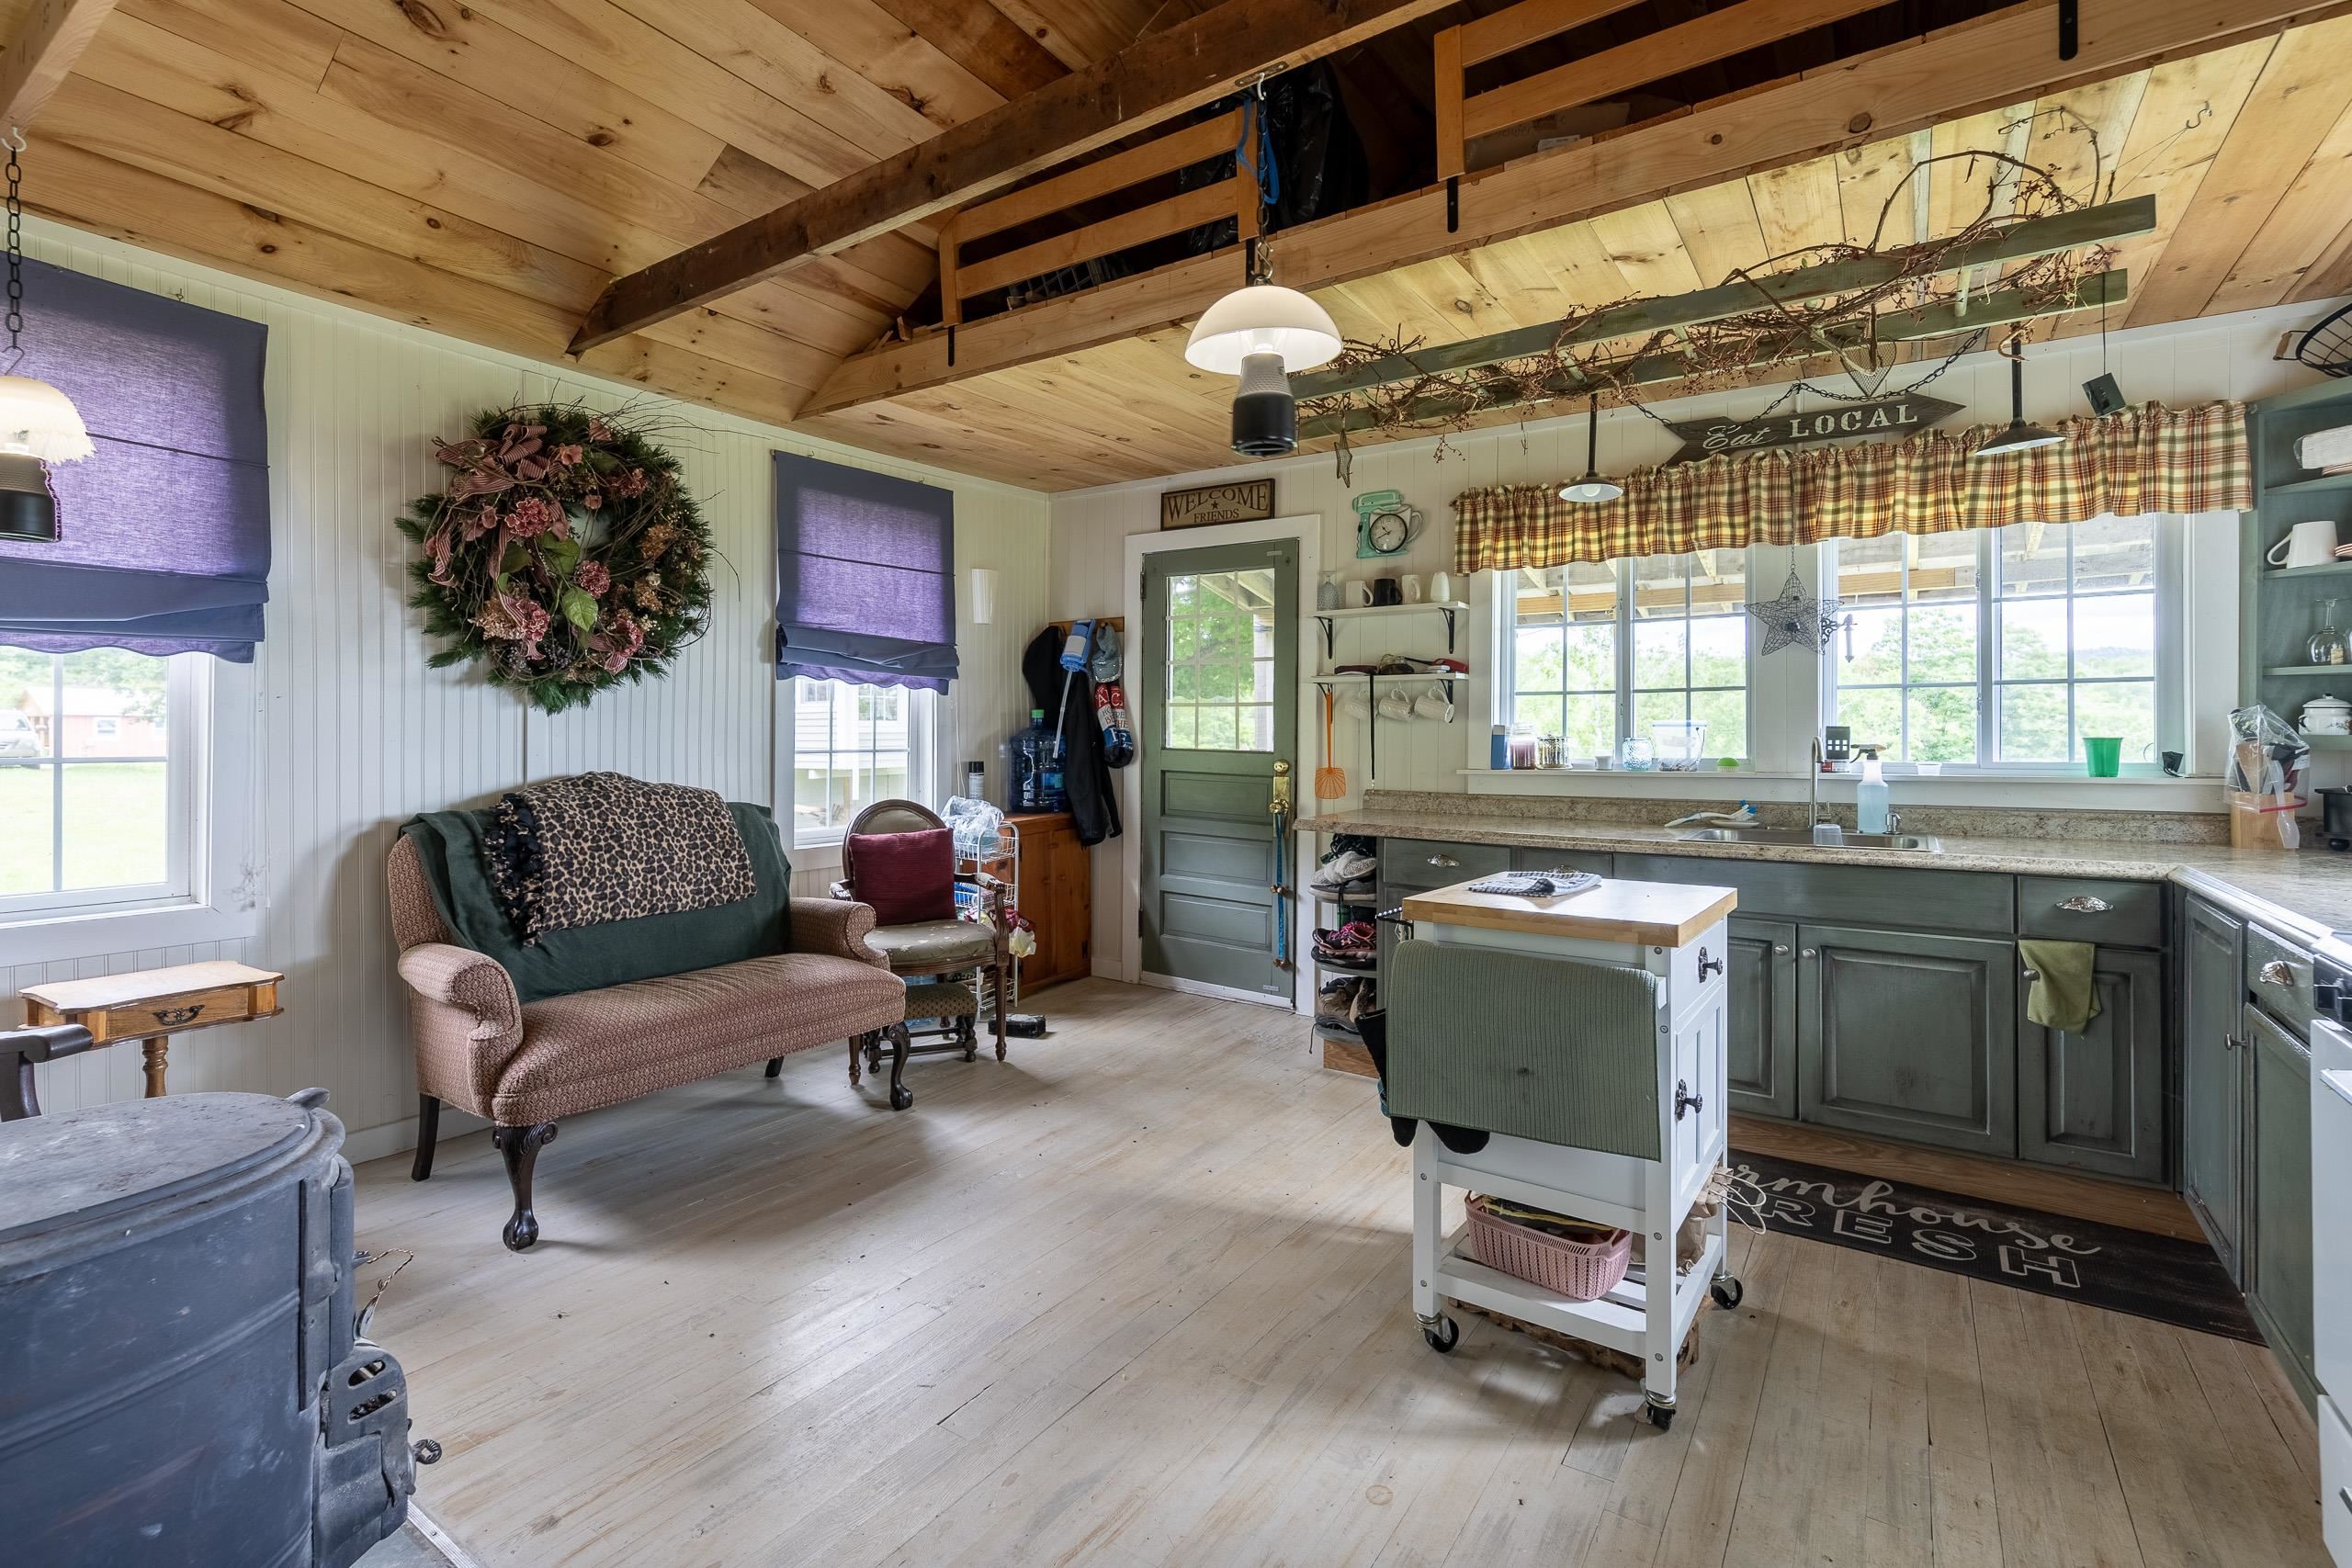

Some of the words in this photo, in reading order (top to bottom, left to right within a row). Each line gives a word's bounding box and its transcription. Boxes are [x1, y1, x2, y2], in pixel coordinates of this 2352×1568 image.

[1702, 424, 1772, 450] Eat
[1789, 403, 1918, 438] LOCAL
[1167, 483, 1268, 522] WELCOME
[1194, 508, 1239, 524] FRIENDS
[1736, 1164, 2102, 1255] rmhouse
[1727, 1185, 2081, 1289] RESH
